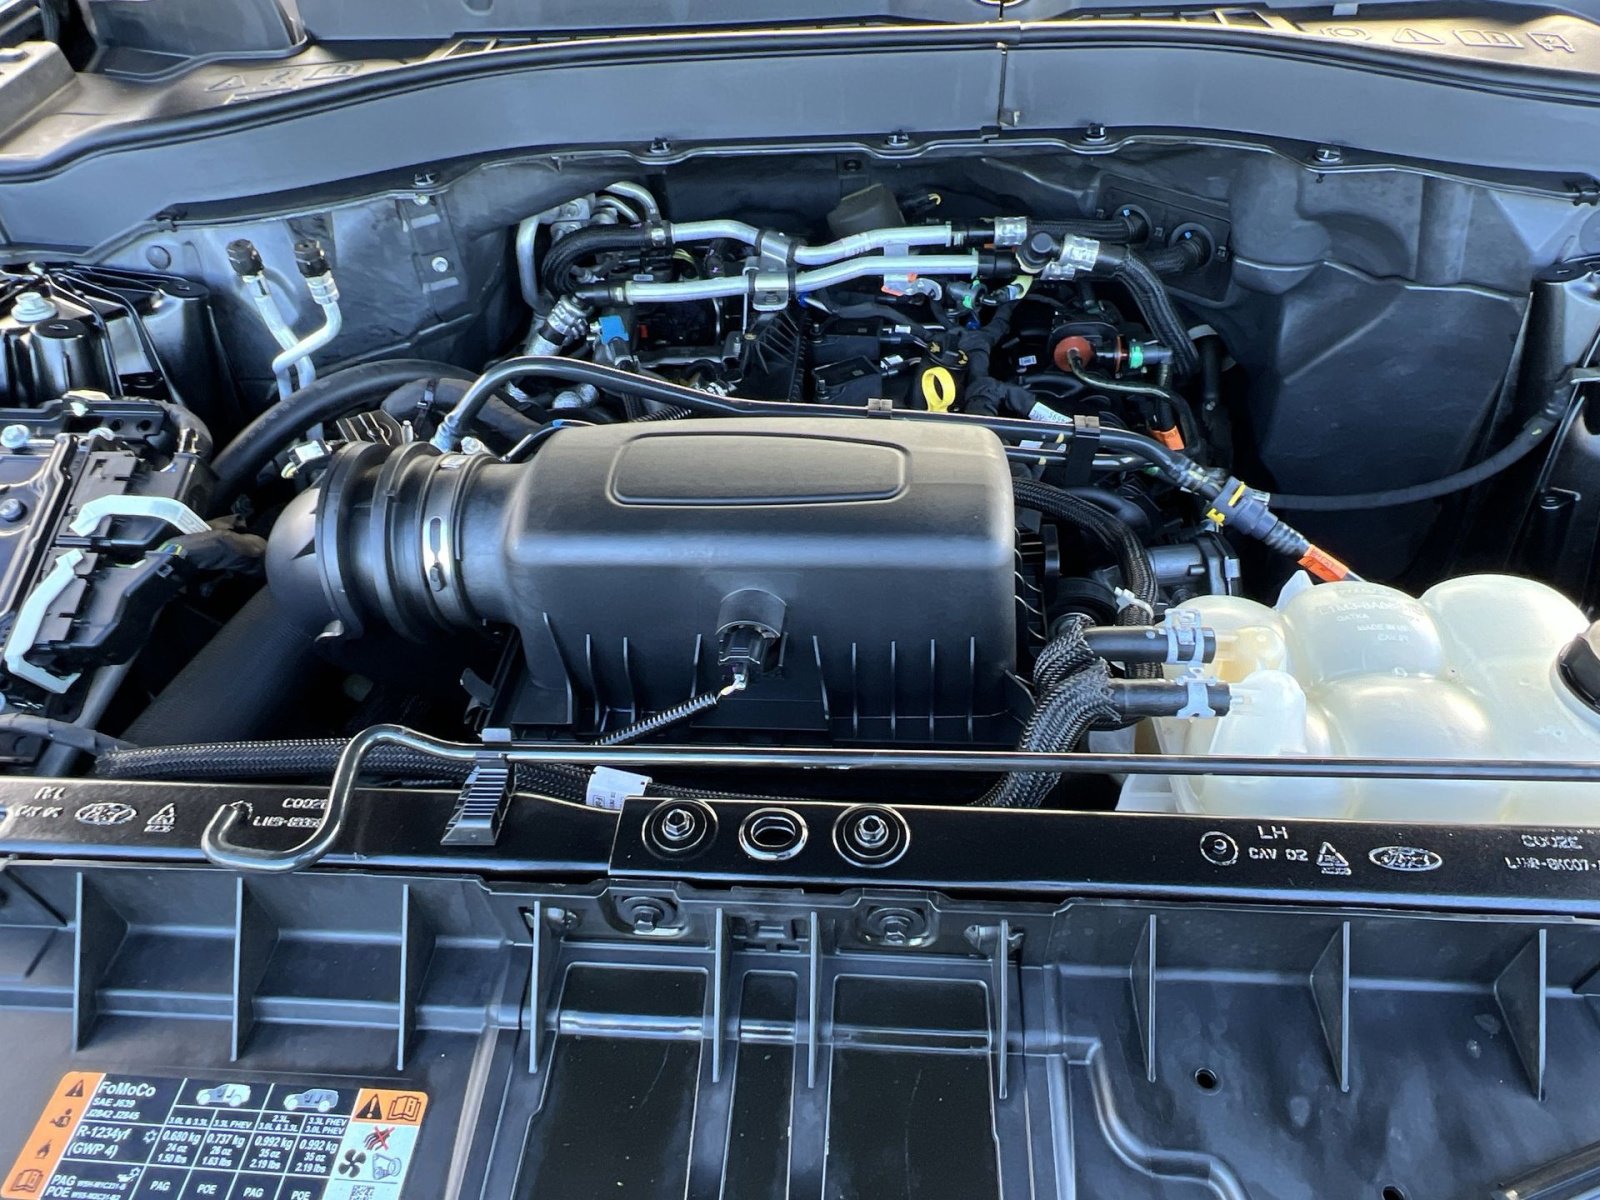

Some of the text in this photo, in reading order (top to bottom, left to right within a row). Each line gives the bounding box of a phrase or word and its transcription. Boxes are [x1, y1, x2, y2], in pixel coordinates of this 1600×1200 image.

[1257, 825, 1288, 839] LH
[98, 1081, 156, 1097] FoMoCo
[92, 1098, 113, 1107] SAE
[76, 1125, 132, 1142] R-1234yf
[188, 1132, 201, 1145] kg
[232, 1134, 245, 1148] kg
[254, 1135, 294, 1150] 0.992 kg
[299, 1139, 338, 1154] 0.992 kg
[67, 1142, 119, 1159] (GWP 4)
[51, 1174, 77, 1187] PAG
[150, 1180, 171, 1191] PAG
[45, 1186, 72, 1198] POE
[196, 1184, 218, 1194] POE
[243, 1187, 264, 1197] PAG
[291, 1190, 311, 1200] POE
